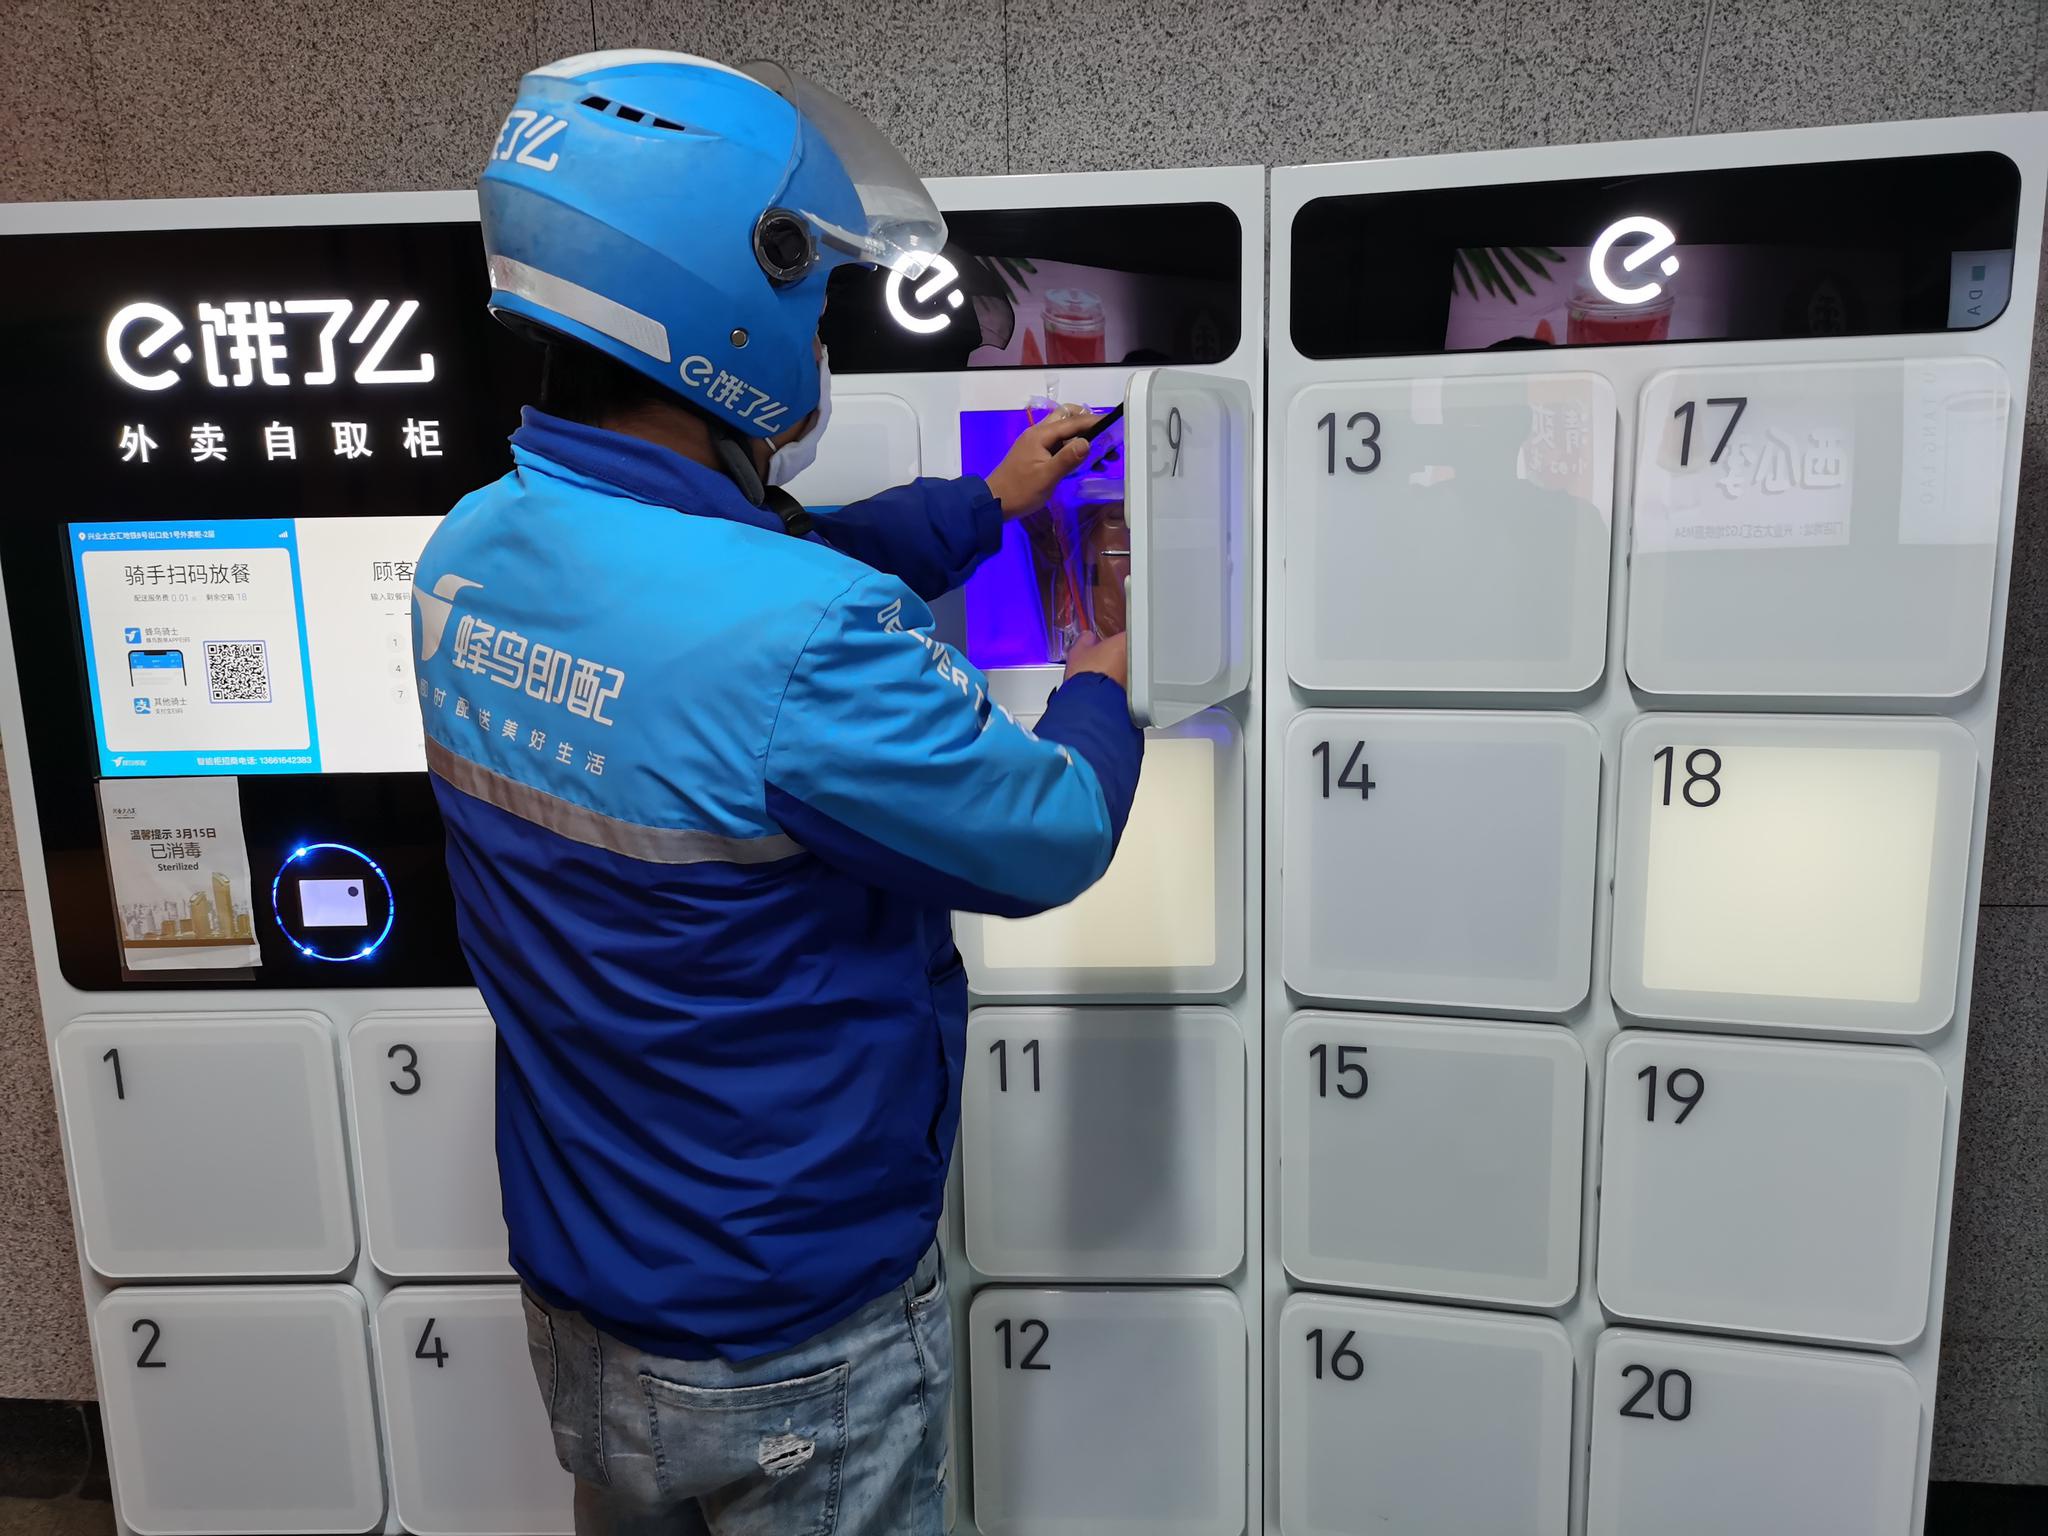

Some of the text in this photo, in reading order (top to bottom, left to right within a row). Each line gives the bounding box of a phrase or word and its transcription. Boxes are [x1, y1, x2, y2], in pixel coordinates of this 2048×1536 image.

[118, 417, 444, 463] 外卖自取柜
[1168, 406, 1183, 478] 9
[1317, 411, 1382, 476] 13
[1674, 397, 1748, 468] 17
[124, 563, 251, 586] 骑手扫码放餐
[372, 560, 418, 582] 顾客
[453, 614, 625, 727] 蜂鸟即配
[1312, 740, 1377, 801] 14
[1653, 746, 1723, 808] 18
[150, 842, 203, 860] 已消毒
[157, 862, 200, 872] Sterilized
[102, 1048, 126, 1100] 1
[387, 1043, 422, 1096] 3
[988, 1039, 1041, 1093] 11
[1309, 1043, 1369, 1100] 15
[1637, 1065, 1706, 1125] 19
[131, 1318, 167, 1369] 2
[414, 1317, 450, 1369] 4
[994, 1319, 1052, 1370] 12
[1306, 1328, 1365, 1382] 16
[1619, 1363, 1693, 1422] 20
